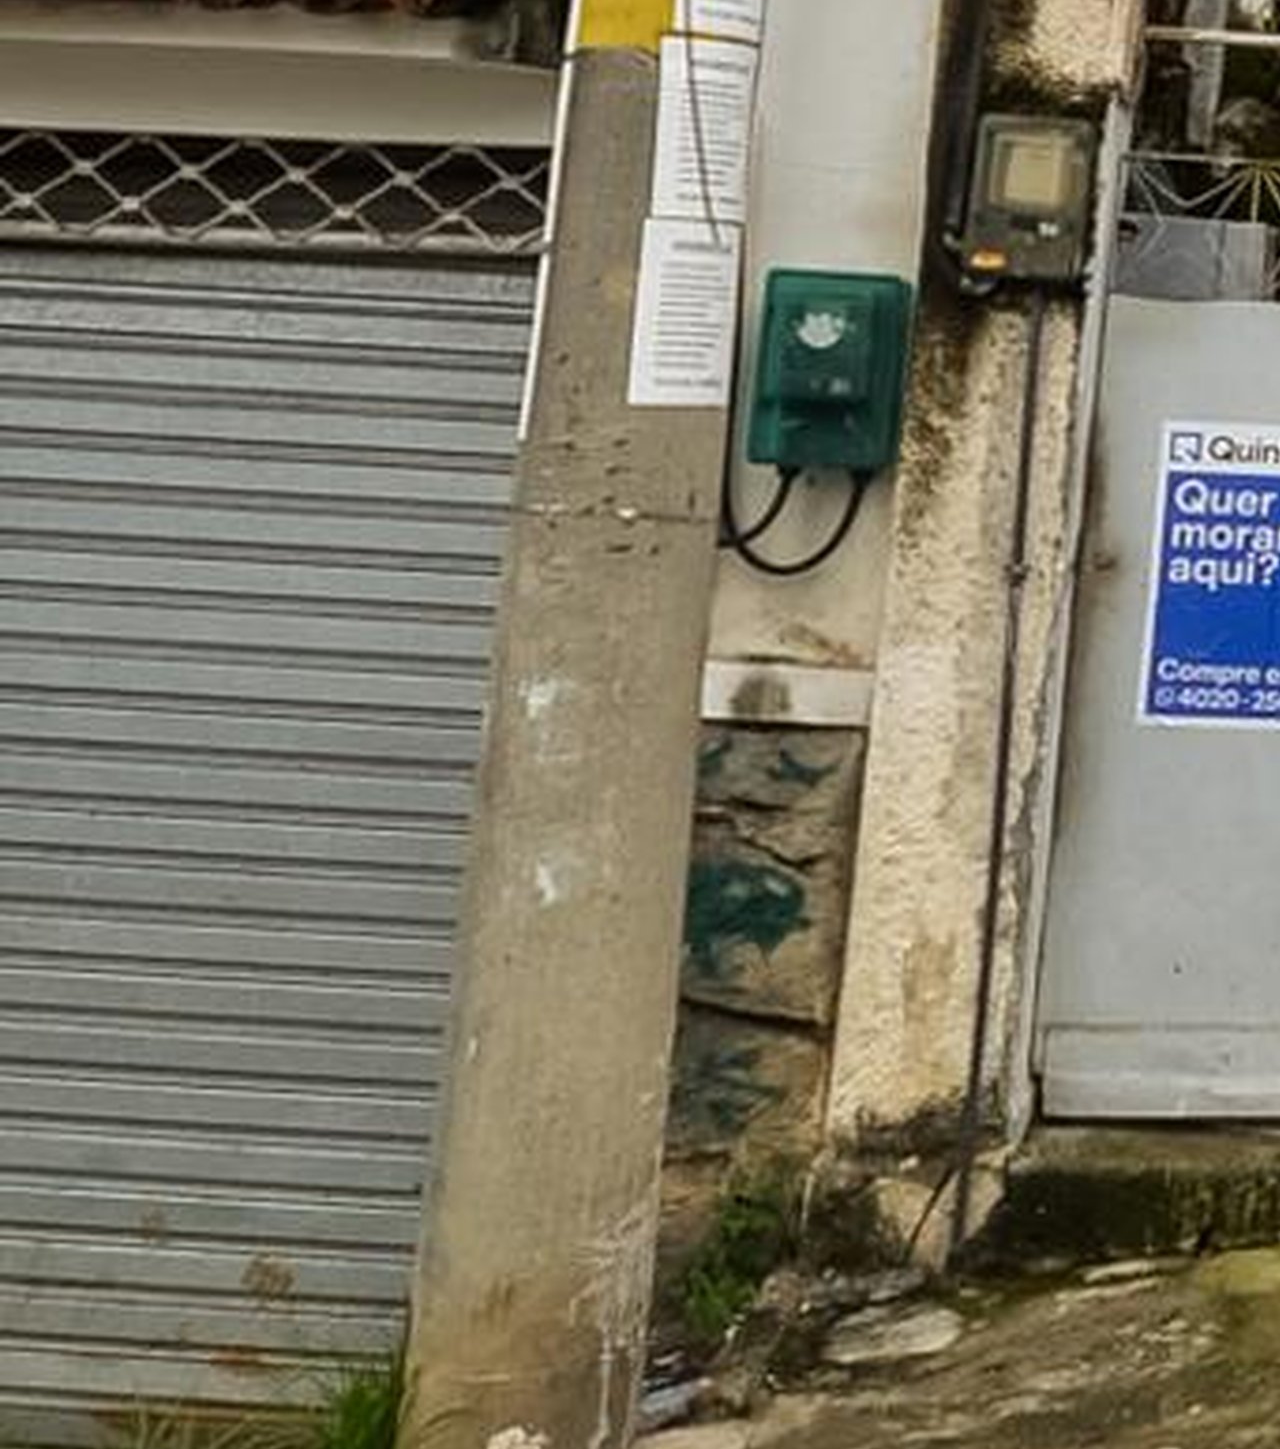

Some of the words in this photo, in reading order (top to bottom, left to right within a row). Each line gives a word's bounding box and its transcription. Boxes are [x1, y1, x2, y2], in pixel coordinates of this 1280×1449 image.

[1174, 478, 1278, 516] Quer
[1168, 552, 1280, 591] aqui?
[1156, 658, 1261, 686] Compre
